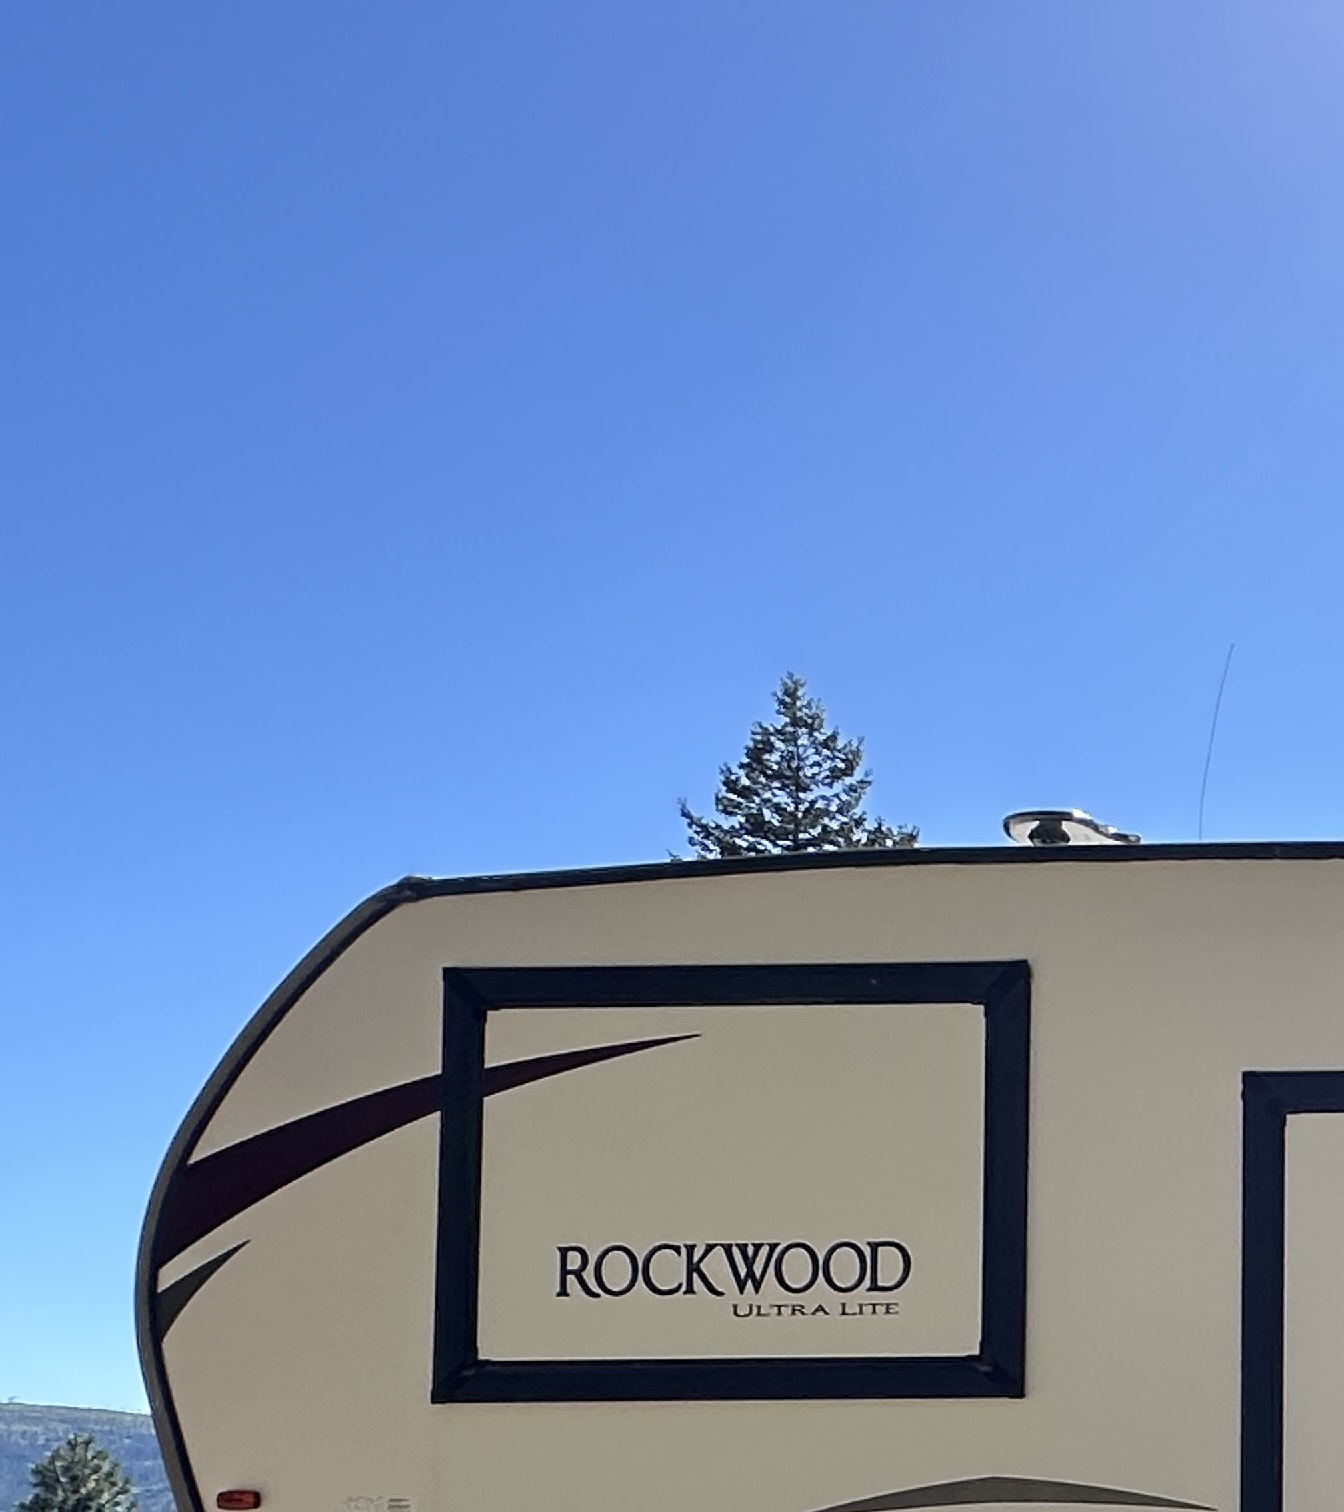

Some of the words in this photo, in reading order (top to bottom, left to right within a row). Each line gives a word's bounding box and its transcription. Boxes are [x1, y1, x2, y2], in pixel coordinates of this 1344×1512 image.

[555, 1240, 912, 1298] ROCKWOOD
[731, 1302, 830, 1318] ULTRA
[839, 1302, 900, 1316] LITE
